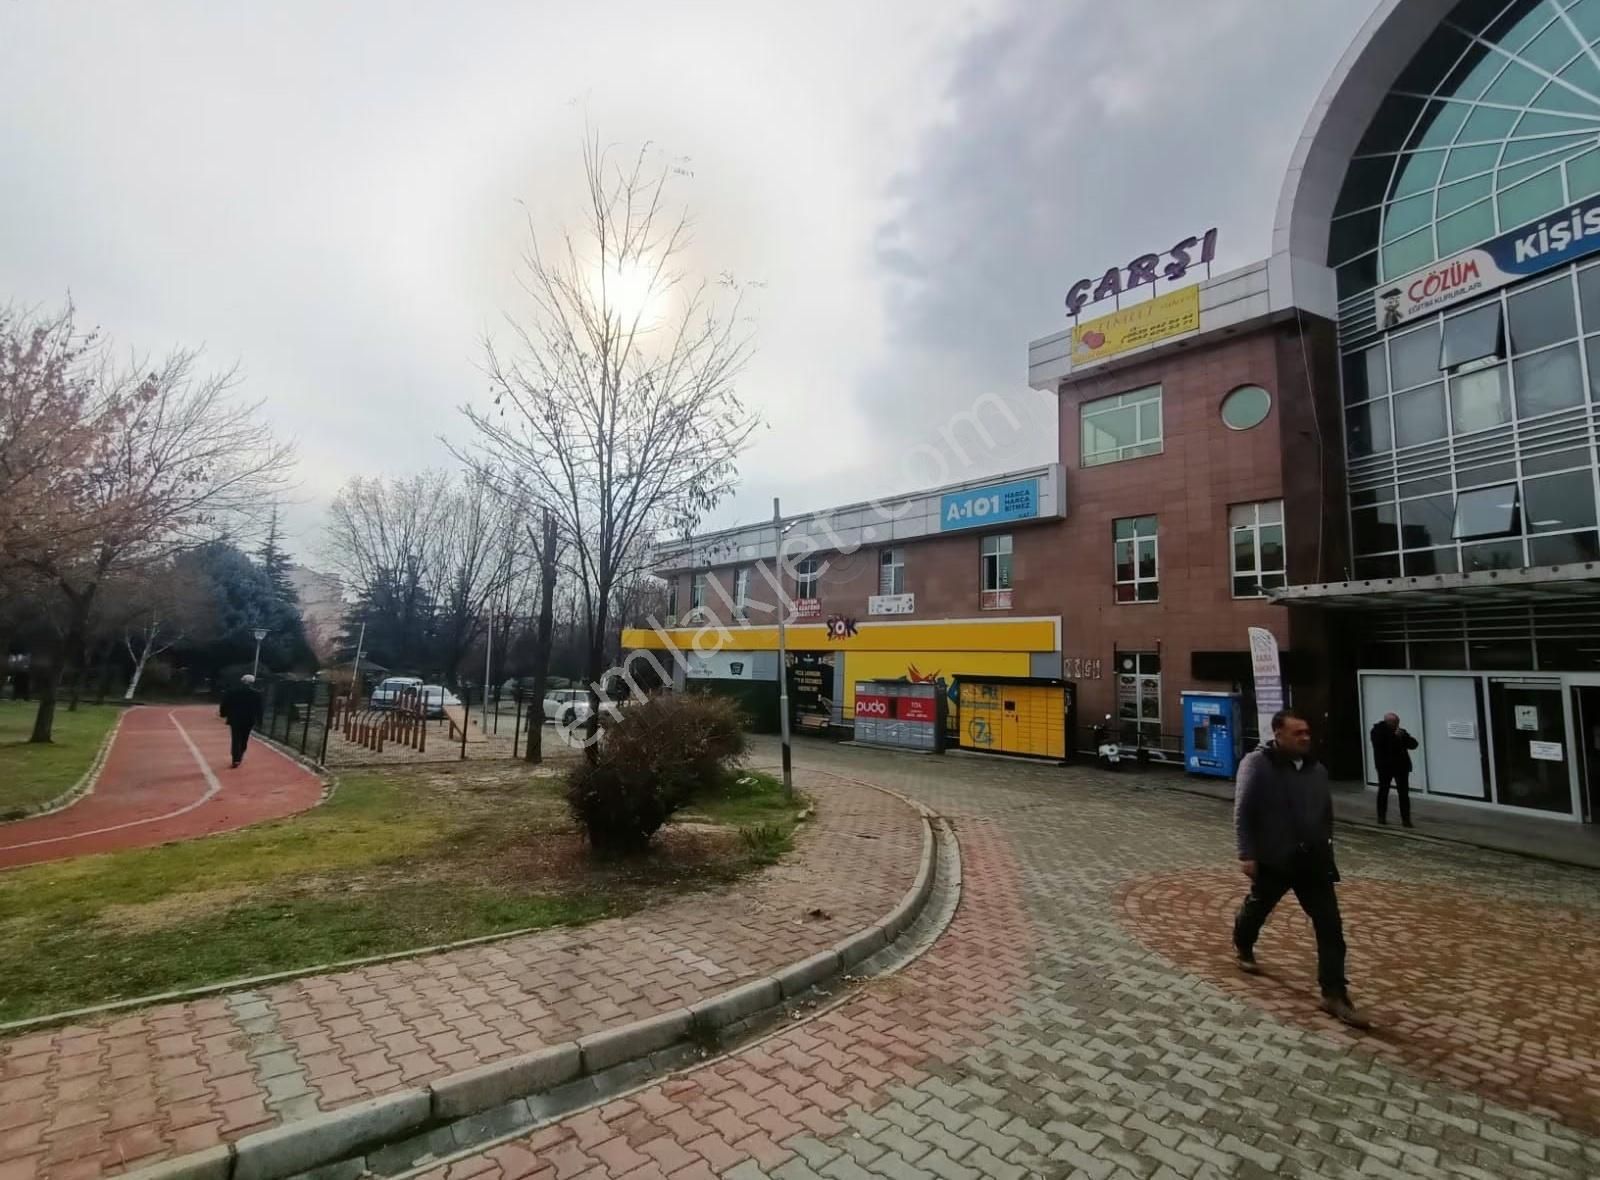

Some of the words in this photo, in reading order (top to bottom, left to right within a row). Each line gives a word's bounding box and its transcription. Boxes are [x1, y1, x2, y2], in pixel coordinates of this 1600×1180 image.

[1065, 227, 1218, 318] ÇARŞI
[1407, 258, 1480, 303] ÇÖZÜM
[856, 699, 886, 715] pudo
